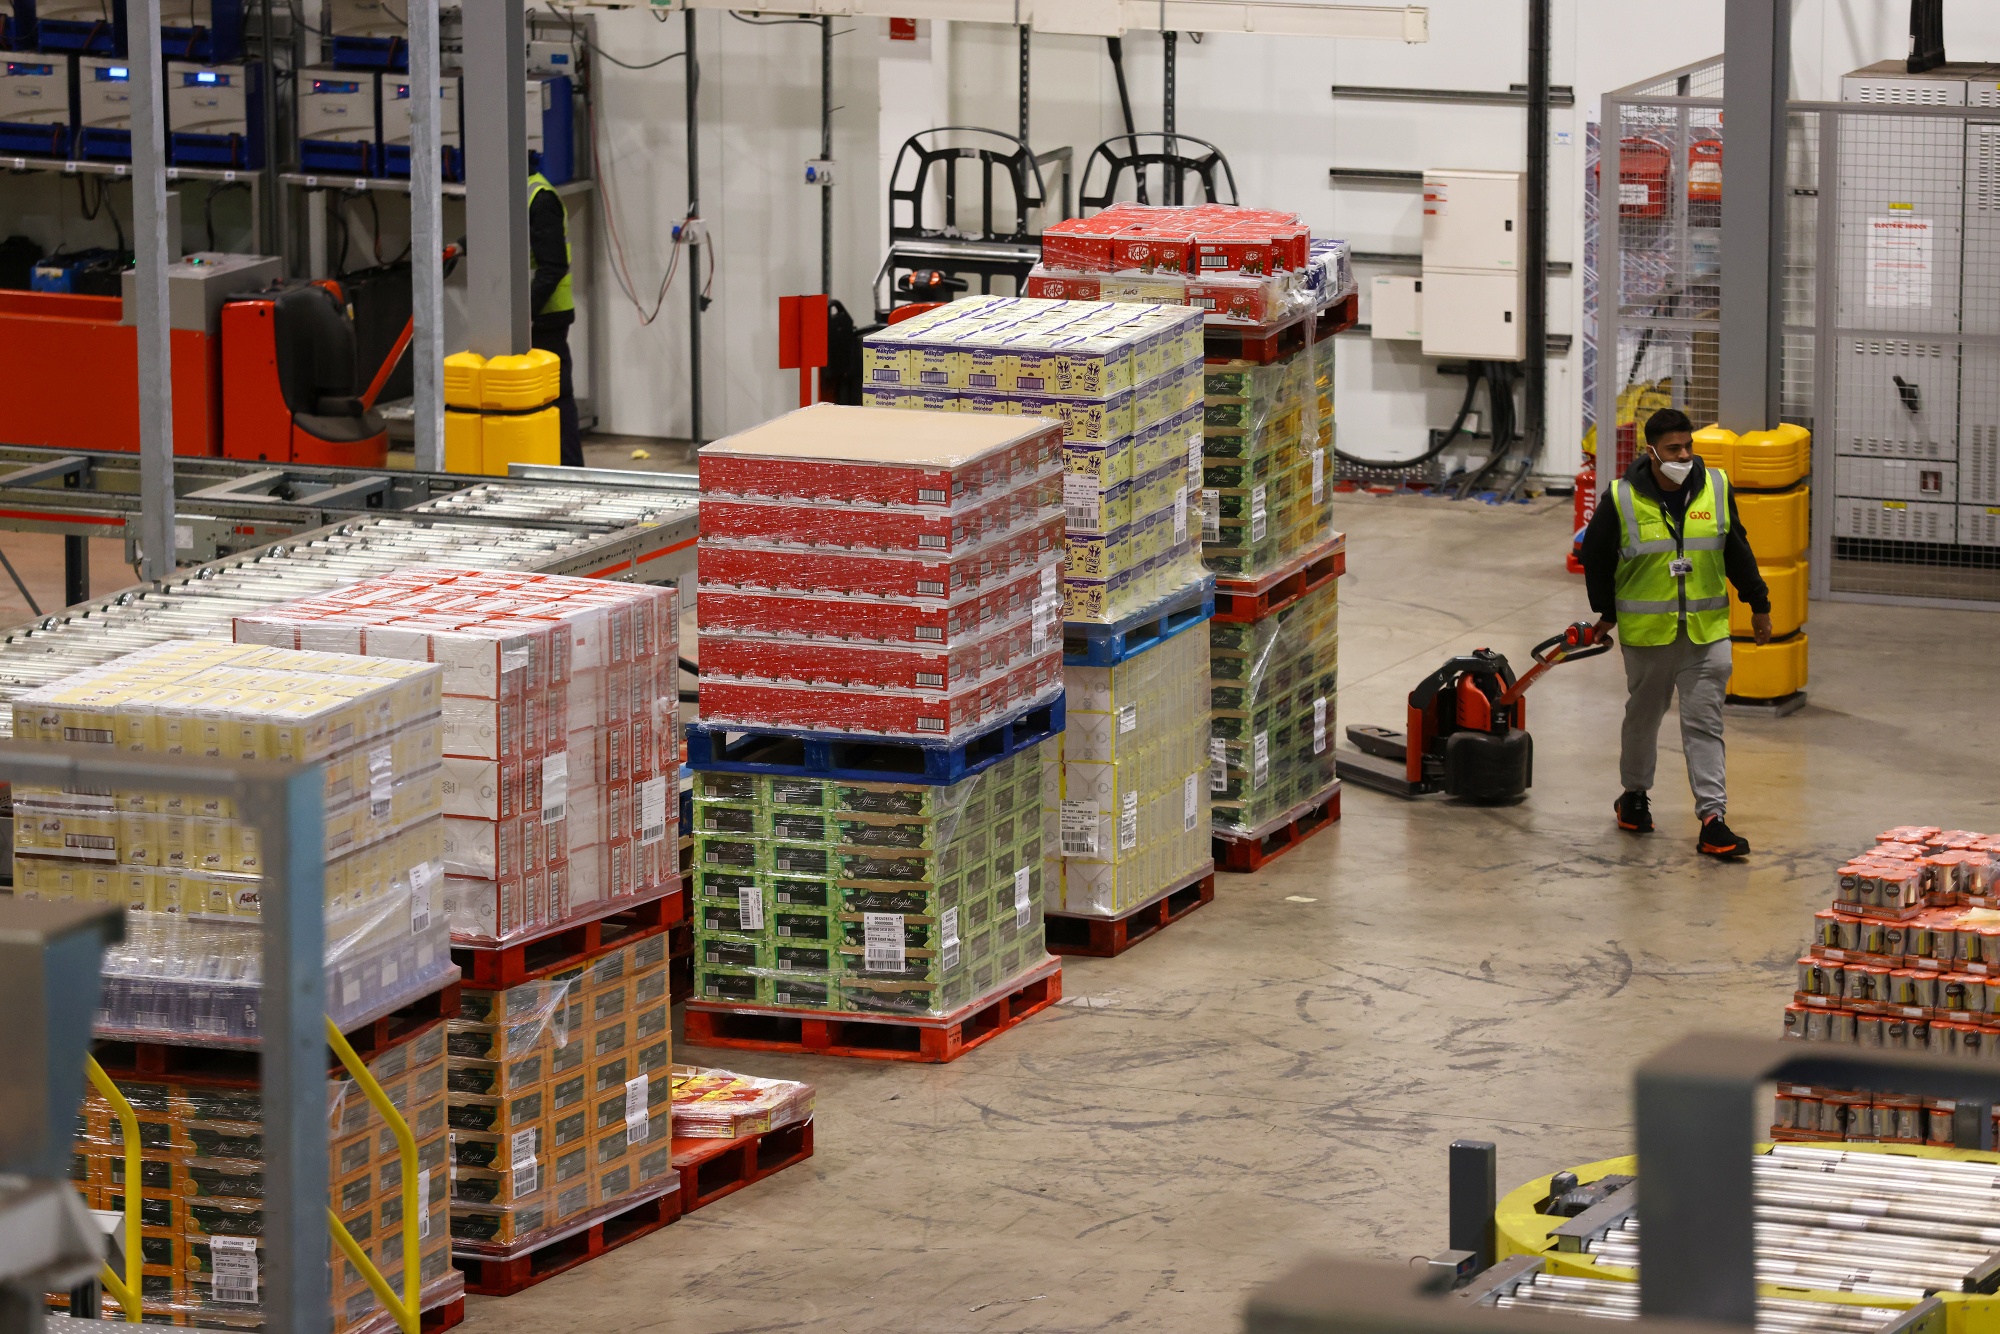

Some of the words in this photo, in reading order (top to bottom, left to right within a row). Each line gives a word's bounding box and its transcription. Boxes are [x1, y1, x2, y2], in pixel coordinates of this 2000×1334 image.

[1128, 247, 1150, 260] KitKat
[1044, 284, 1064, 297] KitKat
[1207, 411, 1228, 422] Eight
[1207, 443, 1228, 454] Eight
[1207, 472, 1228, 482] Eight
[1690, 511, 1711, 520] GXO
[40, 713, 60, 728] Aero
[852, 796, 878, 810] After
[886, 796, 910, 810] Eight
[42, 820, 61, 832] Aero
[855, 830, 880, 844] After
[888, 830, 910, 844] Eight
[805, 852, 819, 860] Eight
[856, 863, 880, 878] After
[890, 863, 912, 878] Eight
[732, 878, 746, 886] Eight
[805, 884, 820, 892] Eight
[856, 896, 882, 910] After
[890, 897, 914, 910] Eight
[806, 918, 820, 926] Eight
[806, 952, 820, 960] Eight
[894, 998, 915, 1008] Eight
[459, 1077, 480, 1088] Eight
[210, 1105, 231, 1116] After
[461, 1114, 484, 1126] Eight
[209, 1143, 233, 1153] After
[462, 1151, 484, 1163] Eight
[208, 1181, 235, 1190] After
[463, 1188, 486, 1200] Eight
[211, 1218, 236, 1229] After
[464, 1224, 487, 1236] Eight
[146, 1242, 162, 1250] Eight
